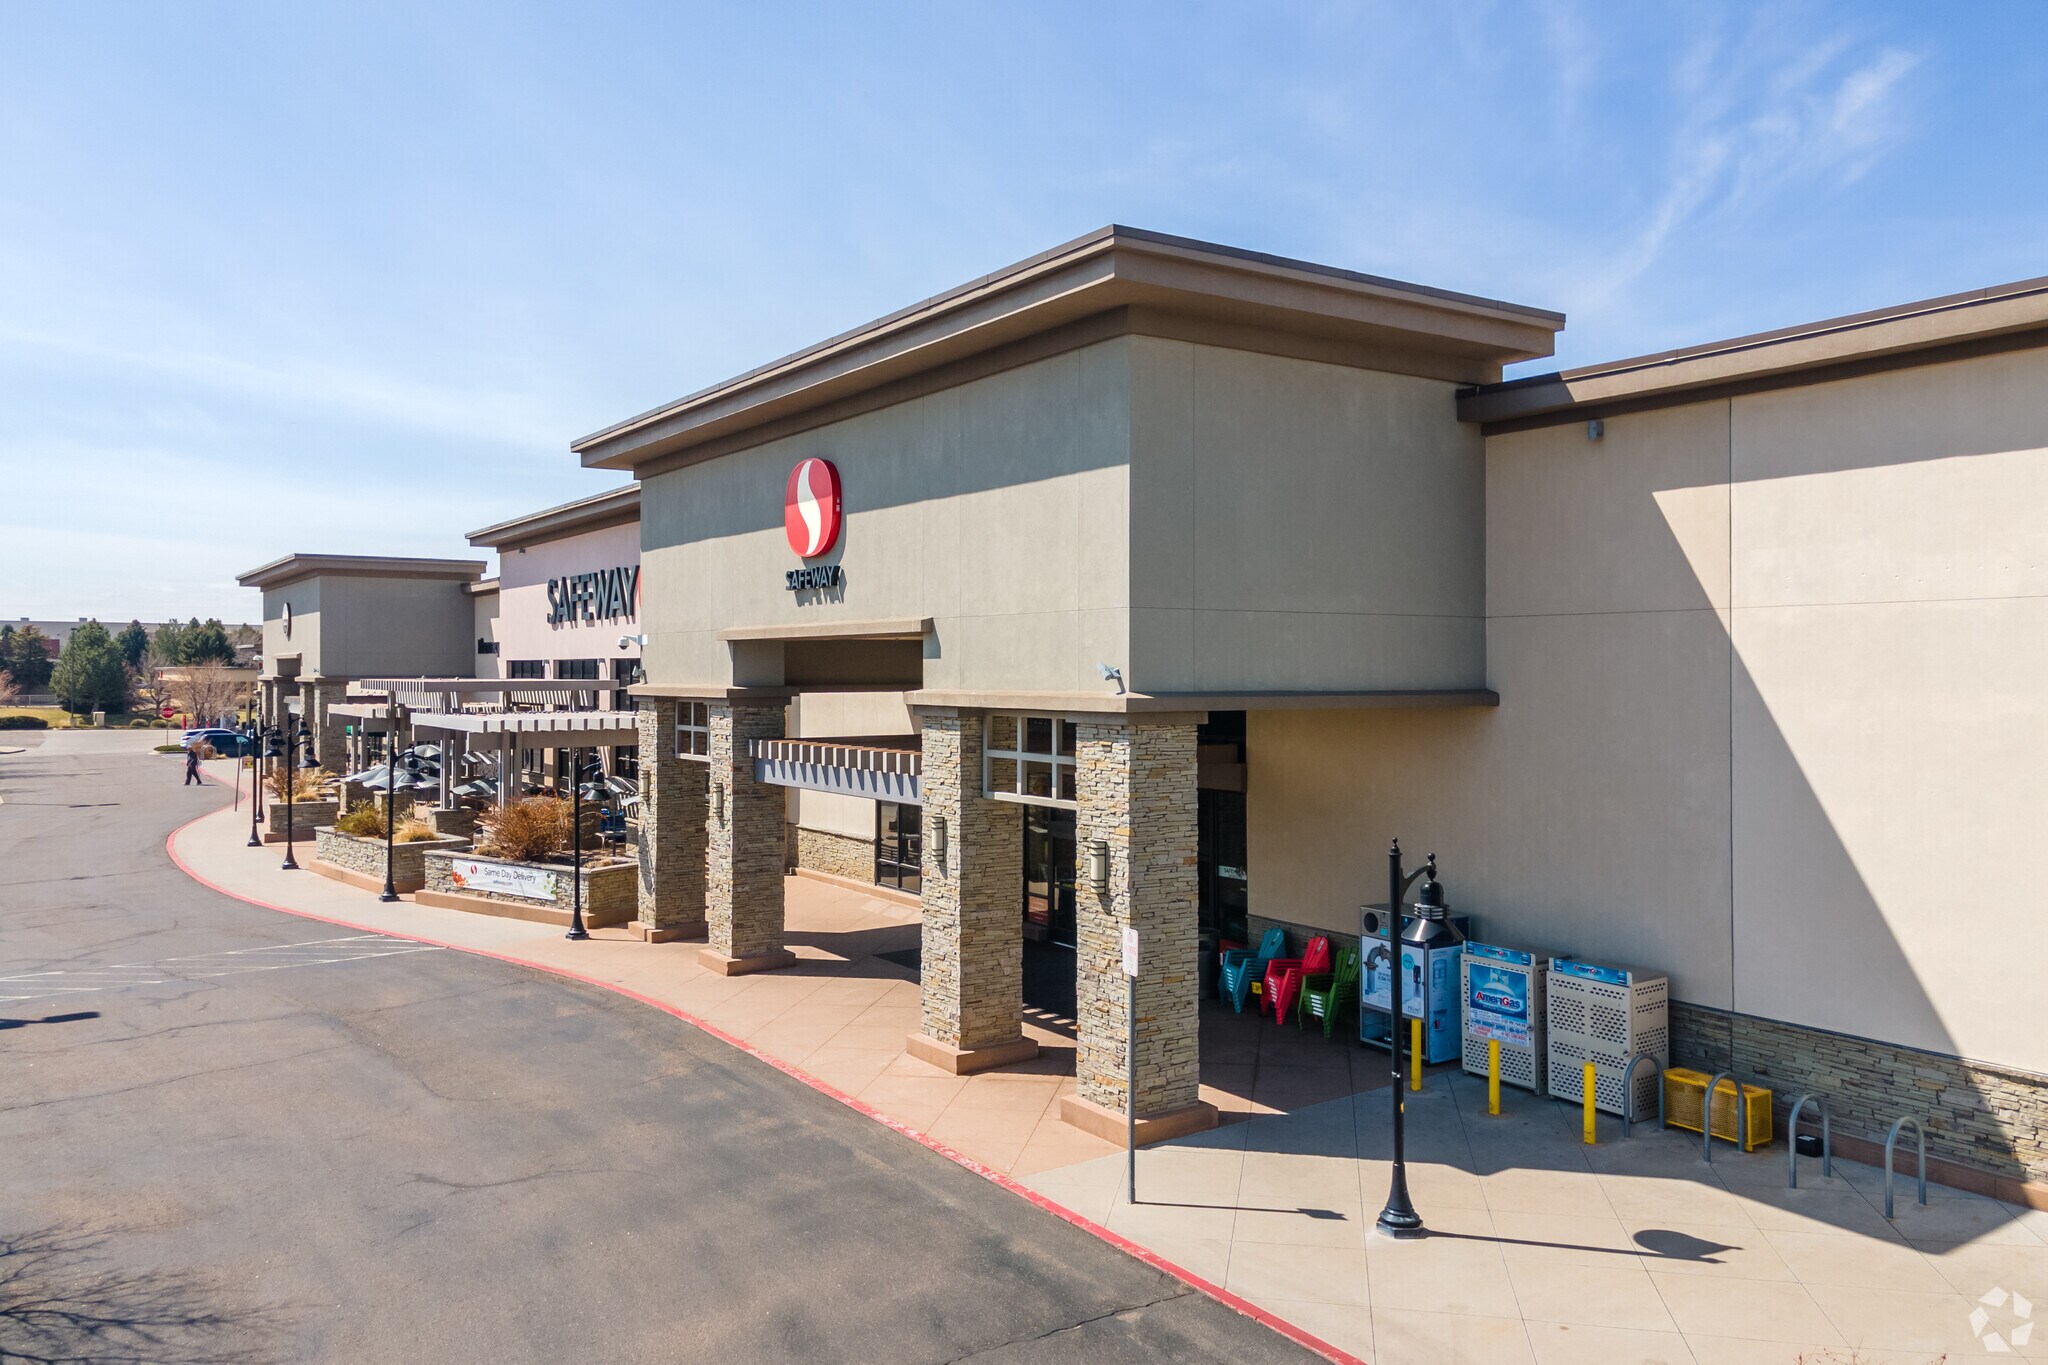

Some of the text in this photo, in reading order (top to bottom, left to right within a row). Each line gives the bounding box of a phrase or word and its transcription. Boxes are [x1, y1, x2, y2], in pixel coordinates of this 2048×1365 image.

[785, 566, 839, 590] SAFEWAY
[547, 565, 640, 624] SAFEWAY
[484, 867, 536, 884] Same Day Delivery
[1476, 991, 1521, 1009] AmeriGas
